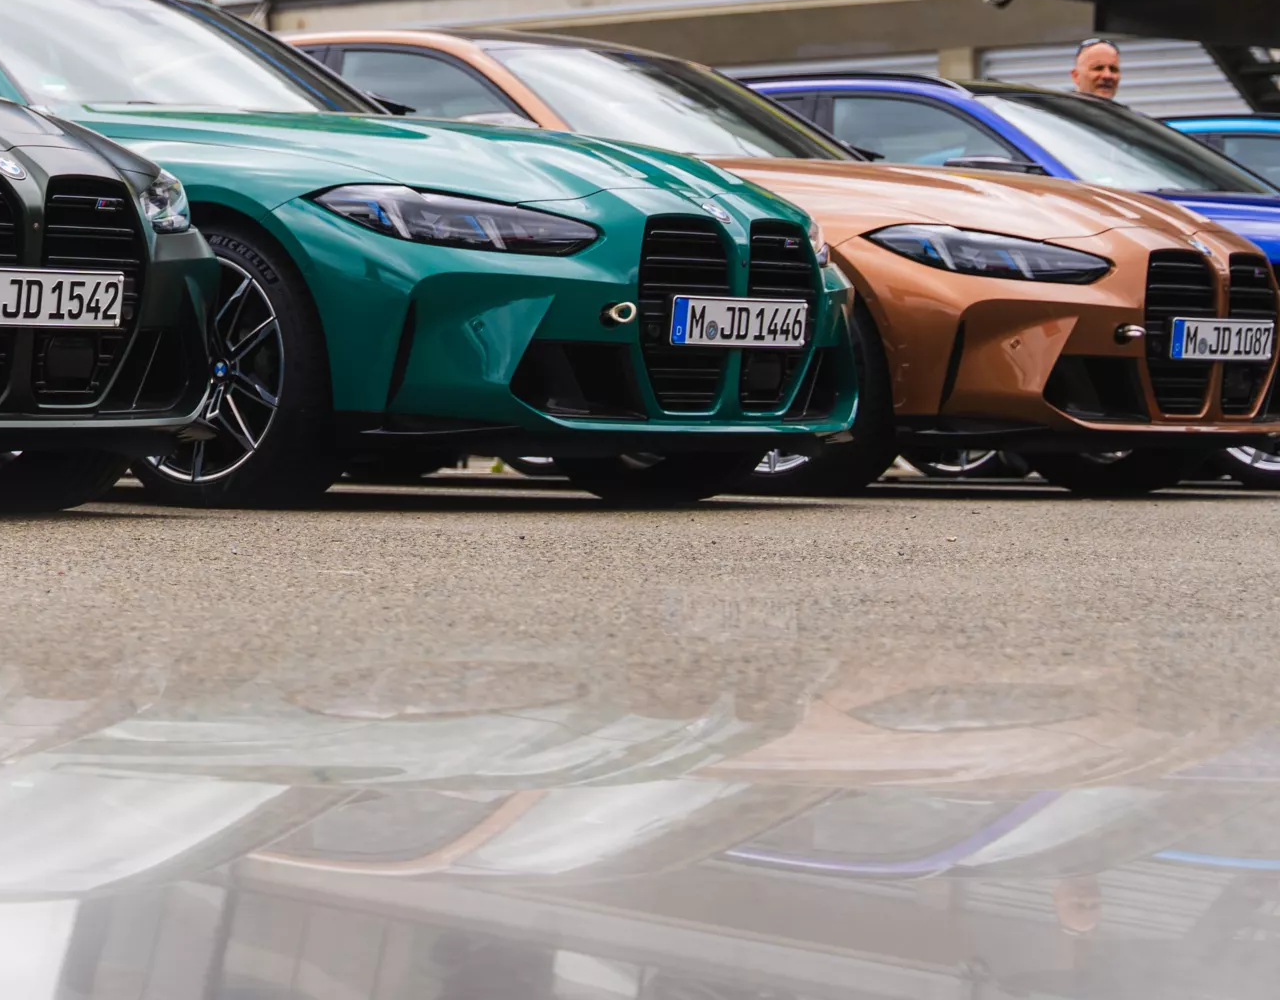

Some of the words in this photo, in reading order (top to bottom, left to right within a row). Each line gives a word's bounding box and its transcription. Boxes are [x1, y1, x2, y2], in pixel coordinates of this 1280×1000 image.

[209, 235, 276, 281] MICHELIN
[2, 279, 43, 319] JD
[48, 281, 120, 320] 1542
[689, 305, 706, 339] M
[720, 306, 750, 340] JD
[753, 308, 802, 342] 1446
[1185, 326, 1199, 354] M
[1208, 327, 1232, 354] JD
[1234, 327, 1271, 355] 1087
